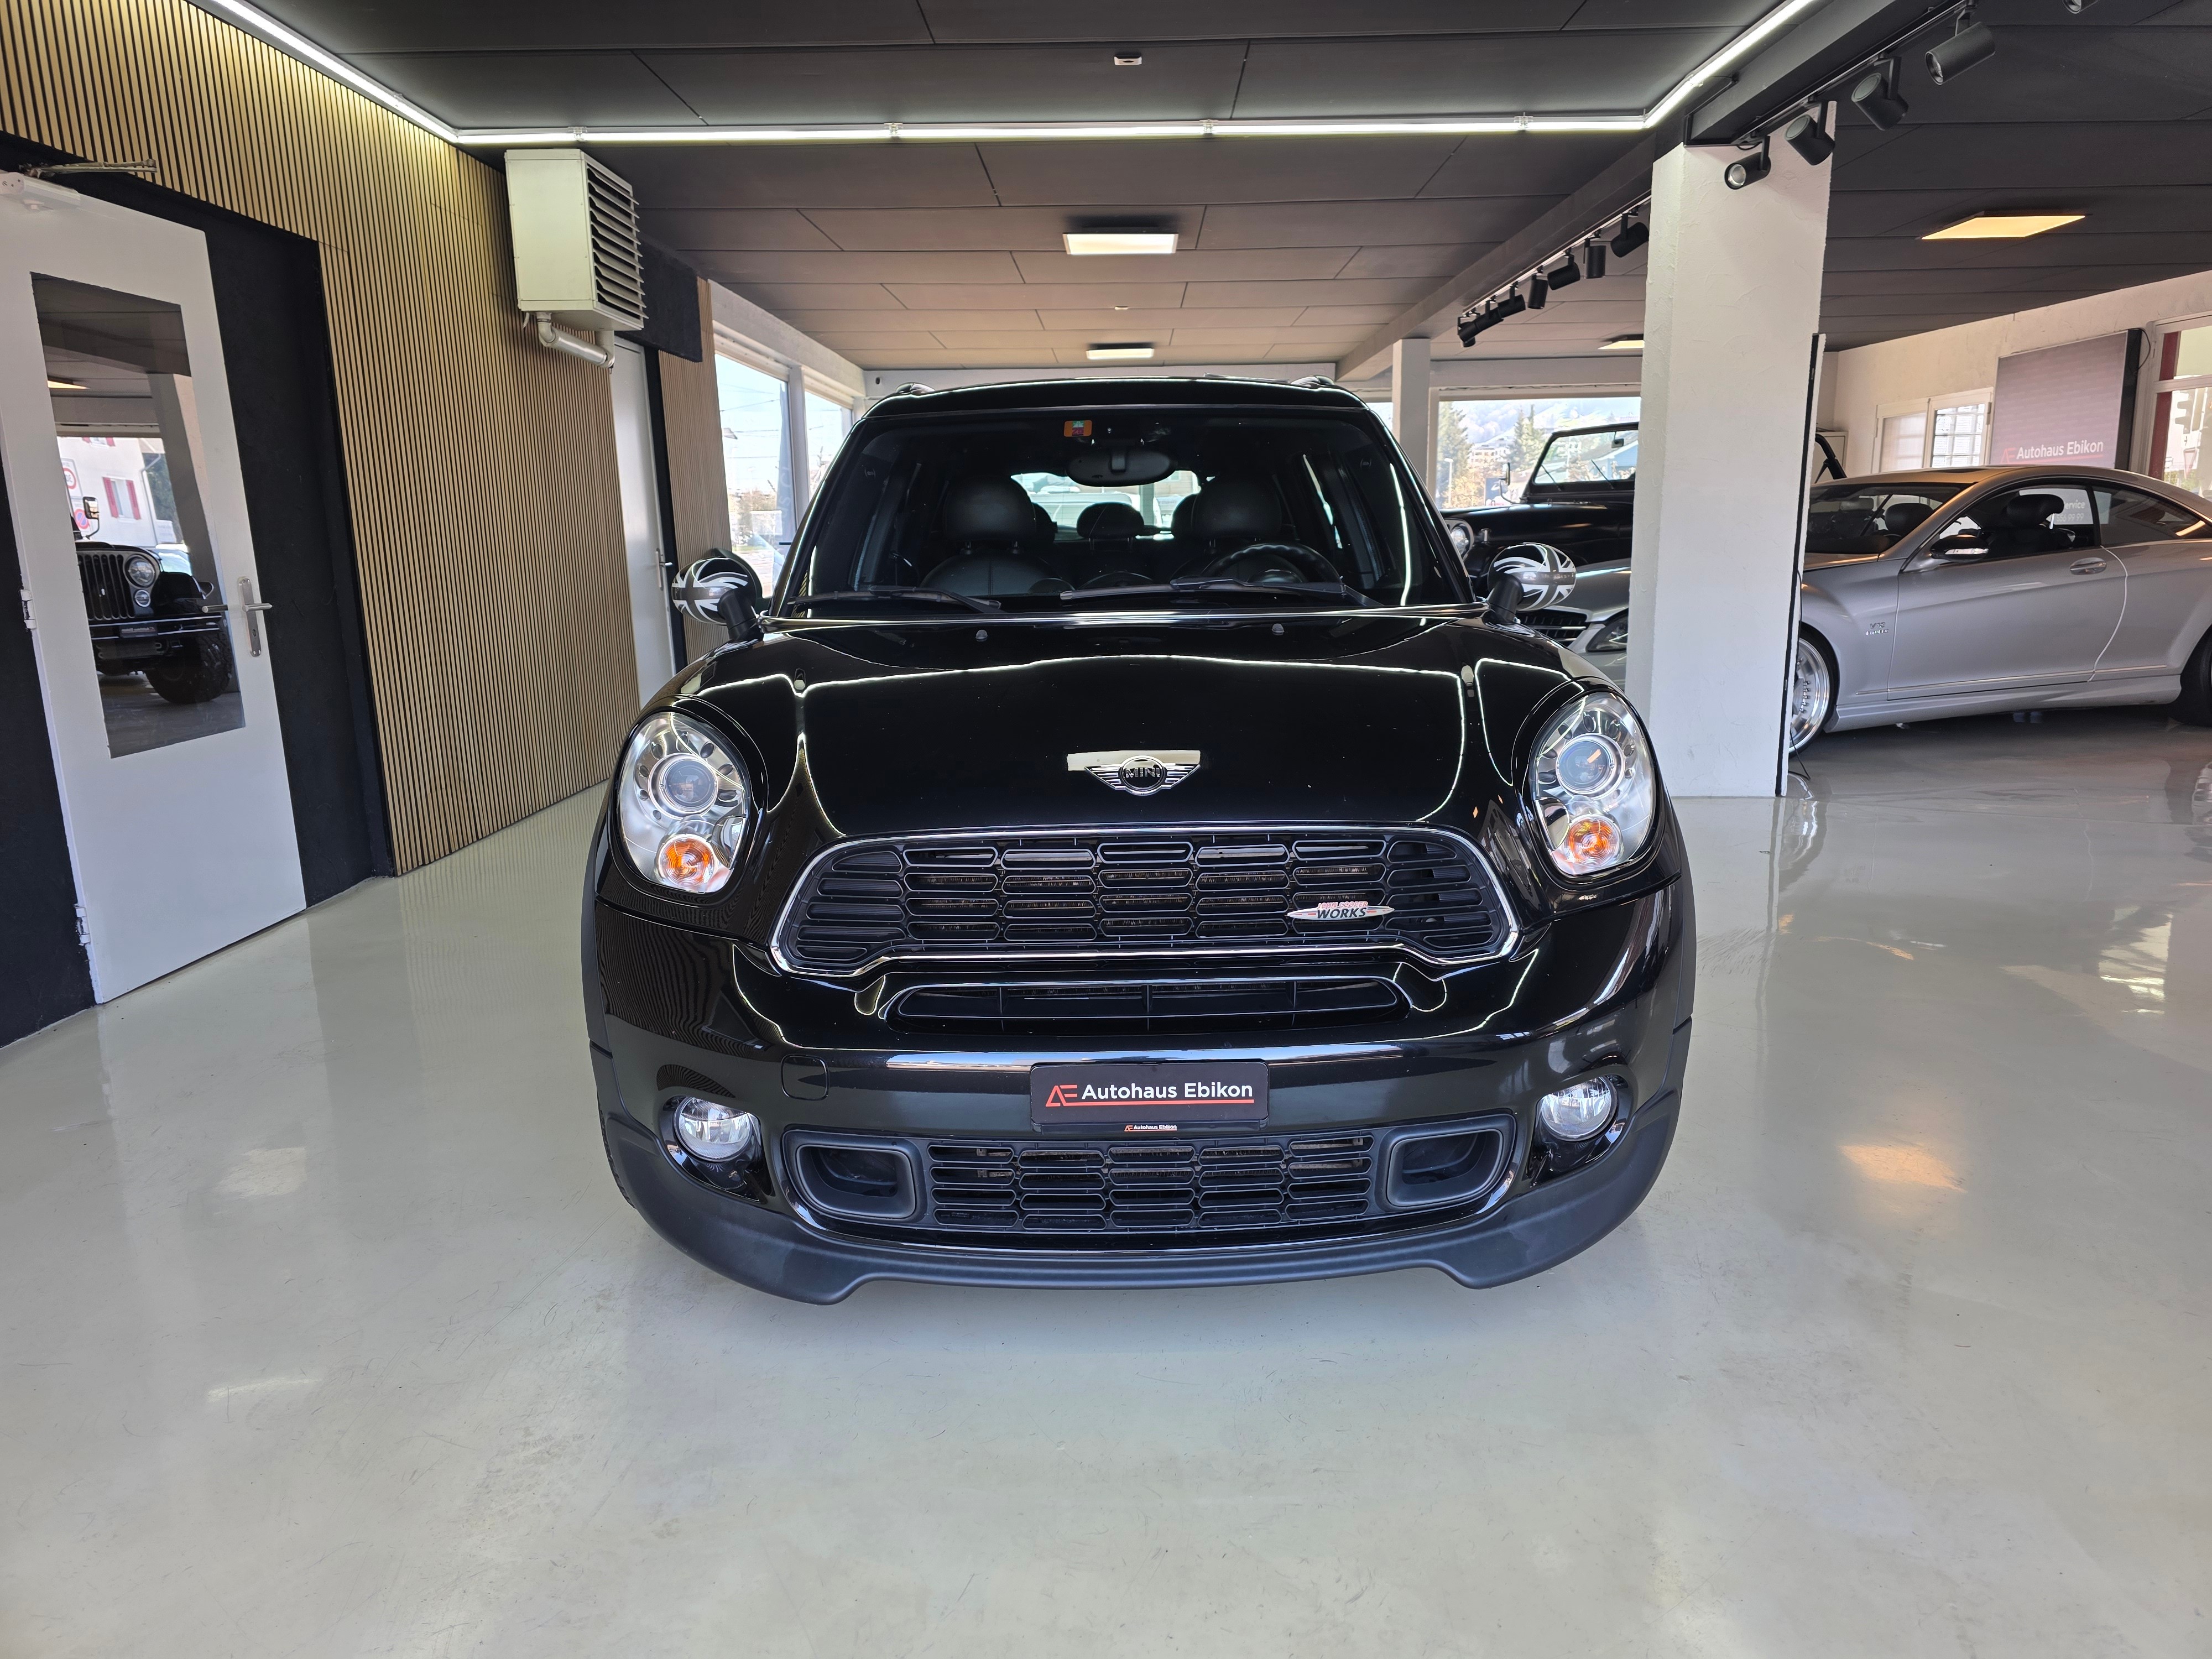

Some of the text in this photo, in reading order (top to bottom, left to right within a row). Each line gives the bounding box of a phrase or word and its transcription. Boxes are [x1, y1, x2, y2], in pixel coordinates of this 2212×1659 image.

[2016, 445, 2064, 460] Autohaus
[2067, 440, 2104, 455] Ebikon
[2064, 499, 2085, 509] ervice
[1125, 767, 1160, 779] MINI
[1317, 907, 1367, 919] WORKS
[1081, 1083, 1178, 1099] Autohaus
[1185, 1082, 1253, 1098] Ebikon
